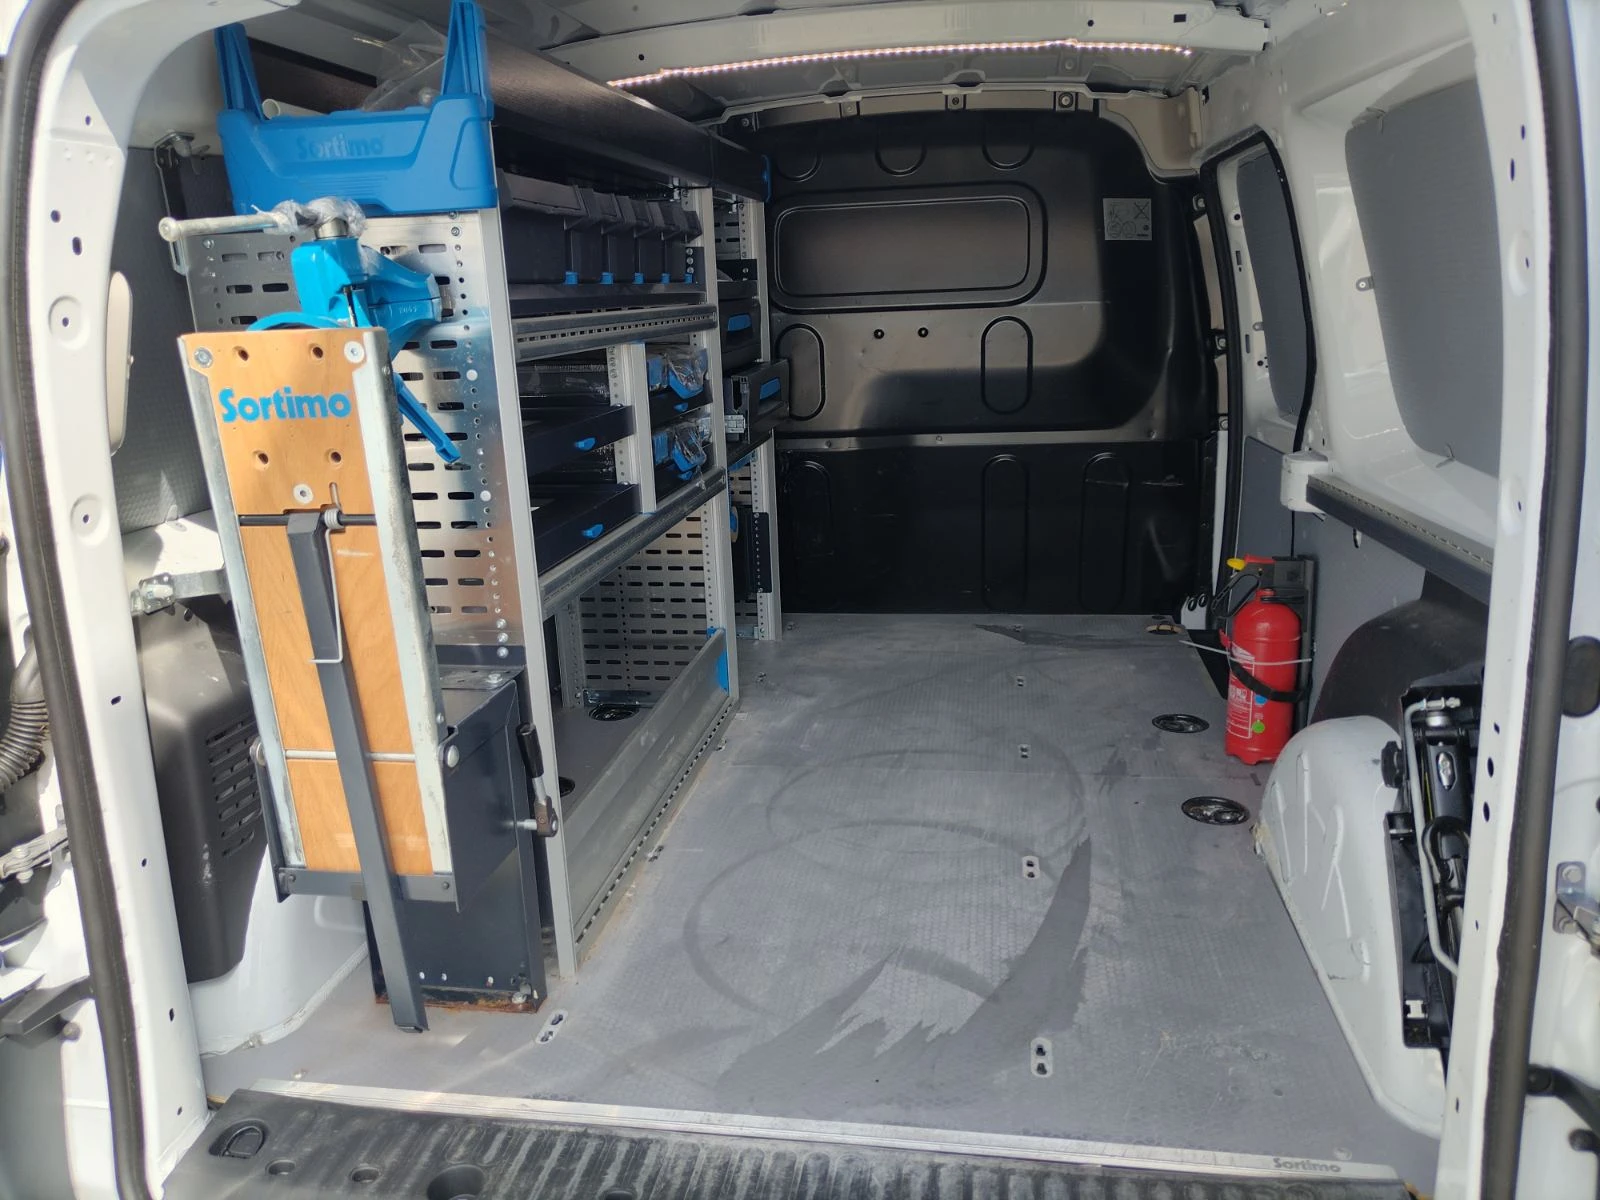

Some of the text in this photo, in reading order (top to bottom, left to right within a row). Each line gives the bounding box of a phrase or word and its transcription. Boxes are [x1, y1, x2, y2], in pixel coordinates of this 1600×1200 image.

[296, 132, 384, 160] Sortimo
[218, 386, 352, 423] Sortimo
[1273, 1157, 1341, 1173] Sortimo
